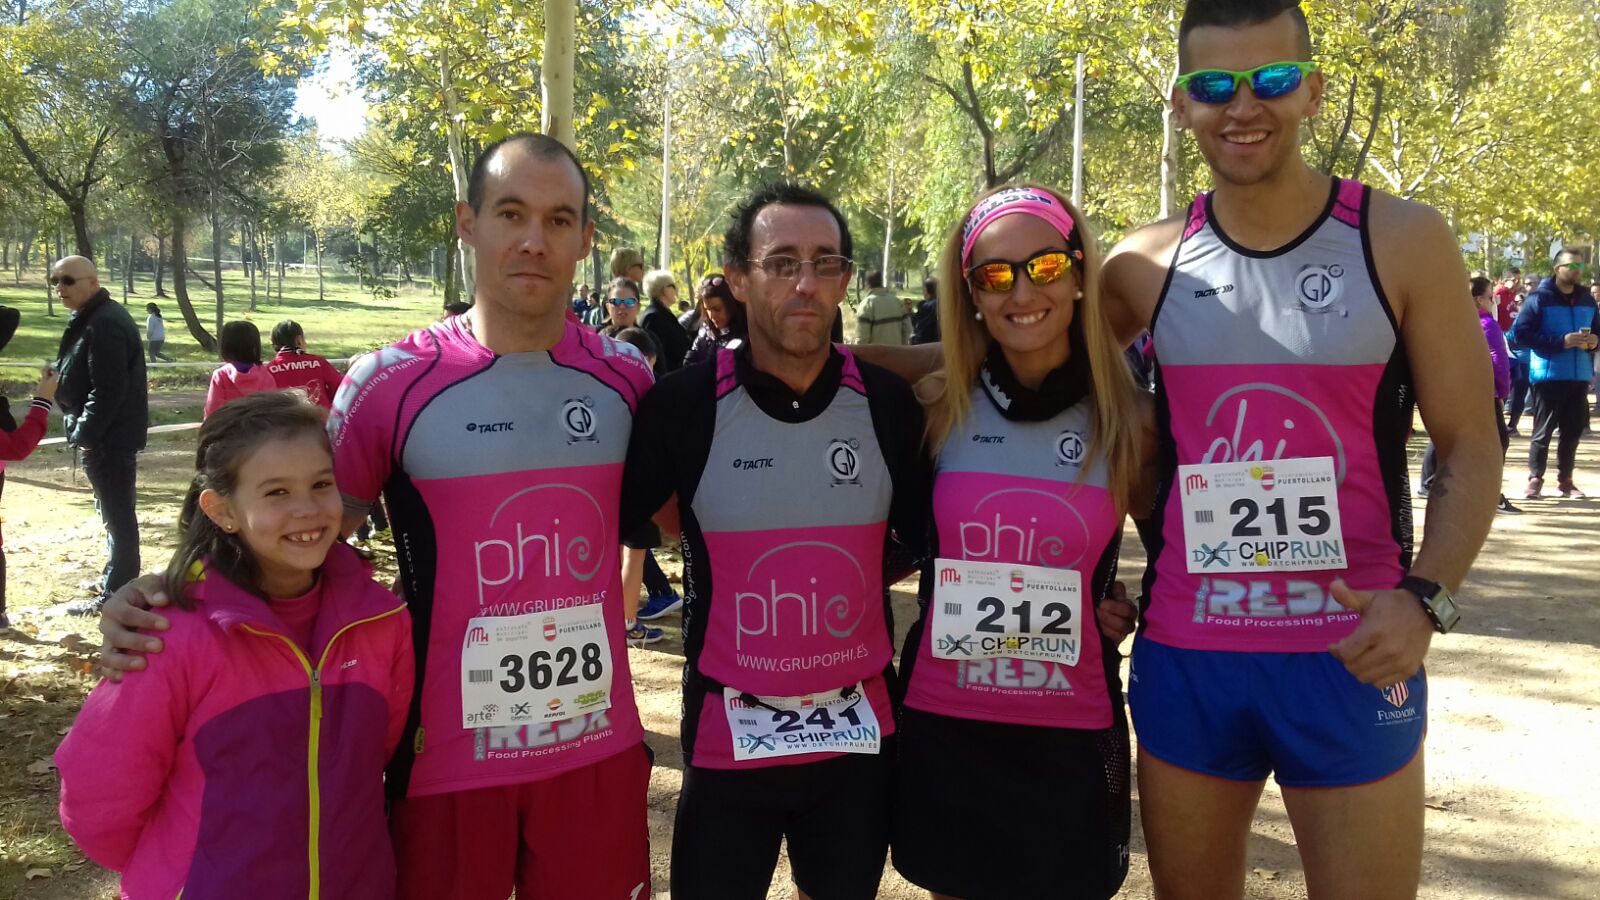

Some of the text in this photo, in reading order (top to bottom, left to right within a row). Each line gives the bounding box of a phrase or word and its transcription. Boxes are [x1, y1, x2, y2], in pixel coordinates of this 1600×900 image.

[1194, 286, 1221, 299] TACTIC
[269, 360, 321, 374] OLYMPIA
[344, 371, 389, 424] Processing
[478, 421, 514, 434] TACTIC
[980, 435, 1006, 444] TACTIC
[743, 458, 774, 470] TACTIC
[1278, 477, 1331, 485] PUERTOLLANO
[1229, 496, 1331, 537] 215
[1027, 584, 1078, 593] PUERTOLLANO
[975, 596, 1072, 634] 212
[1207, 616, 1240, 626] Food
[1244, 617, 1323, 628] Processing
[559, 622, 602, 634] PUERTOLLANO
[736, 643, 869, 672] WWW.GRUPOPHI.ES
[500, 642, 603, 693] 3628
[966, 683, 1075, 697] Food Processing Plants
[467, 711, 493, 723] arte
[772, 707, 862, 733] 241
[784, 726, 876, 743] CHIPRUN
[487, 729, 614, 759] Food Processing Plants
